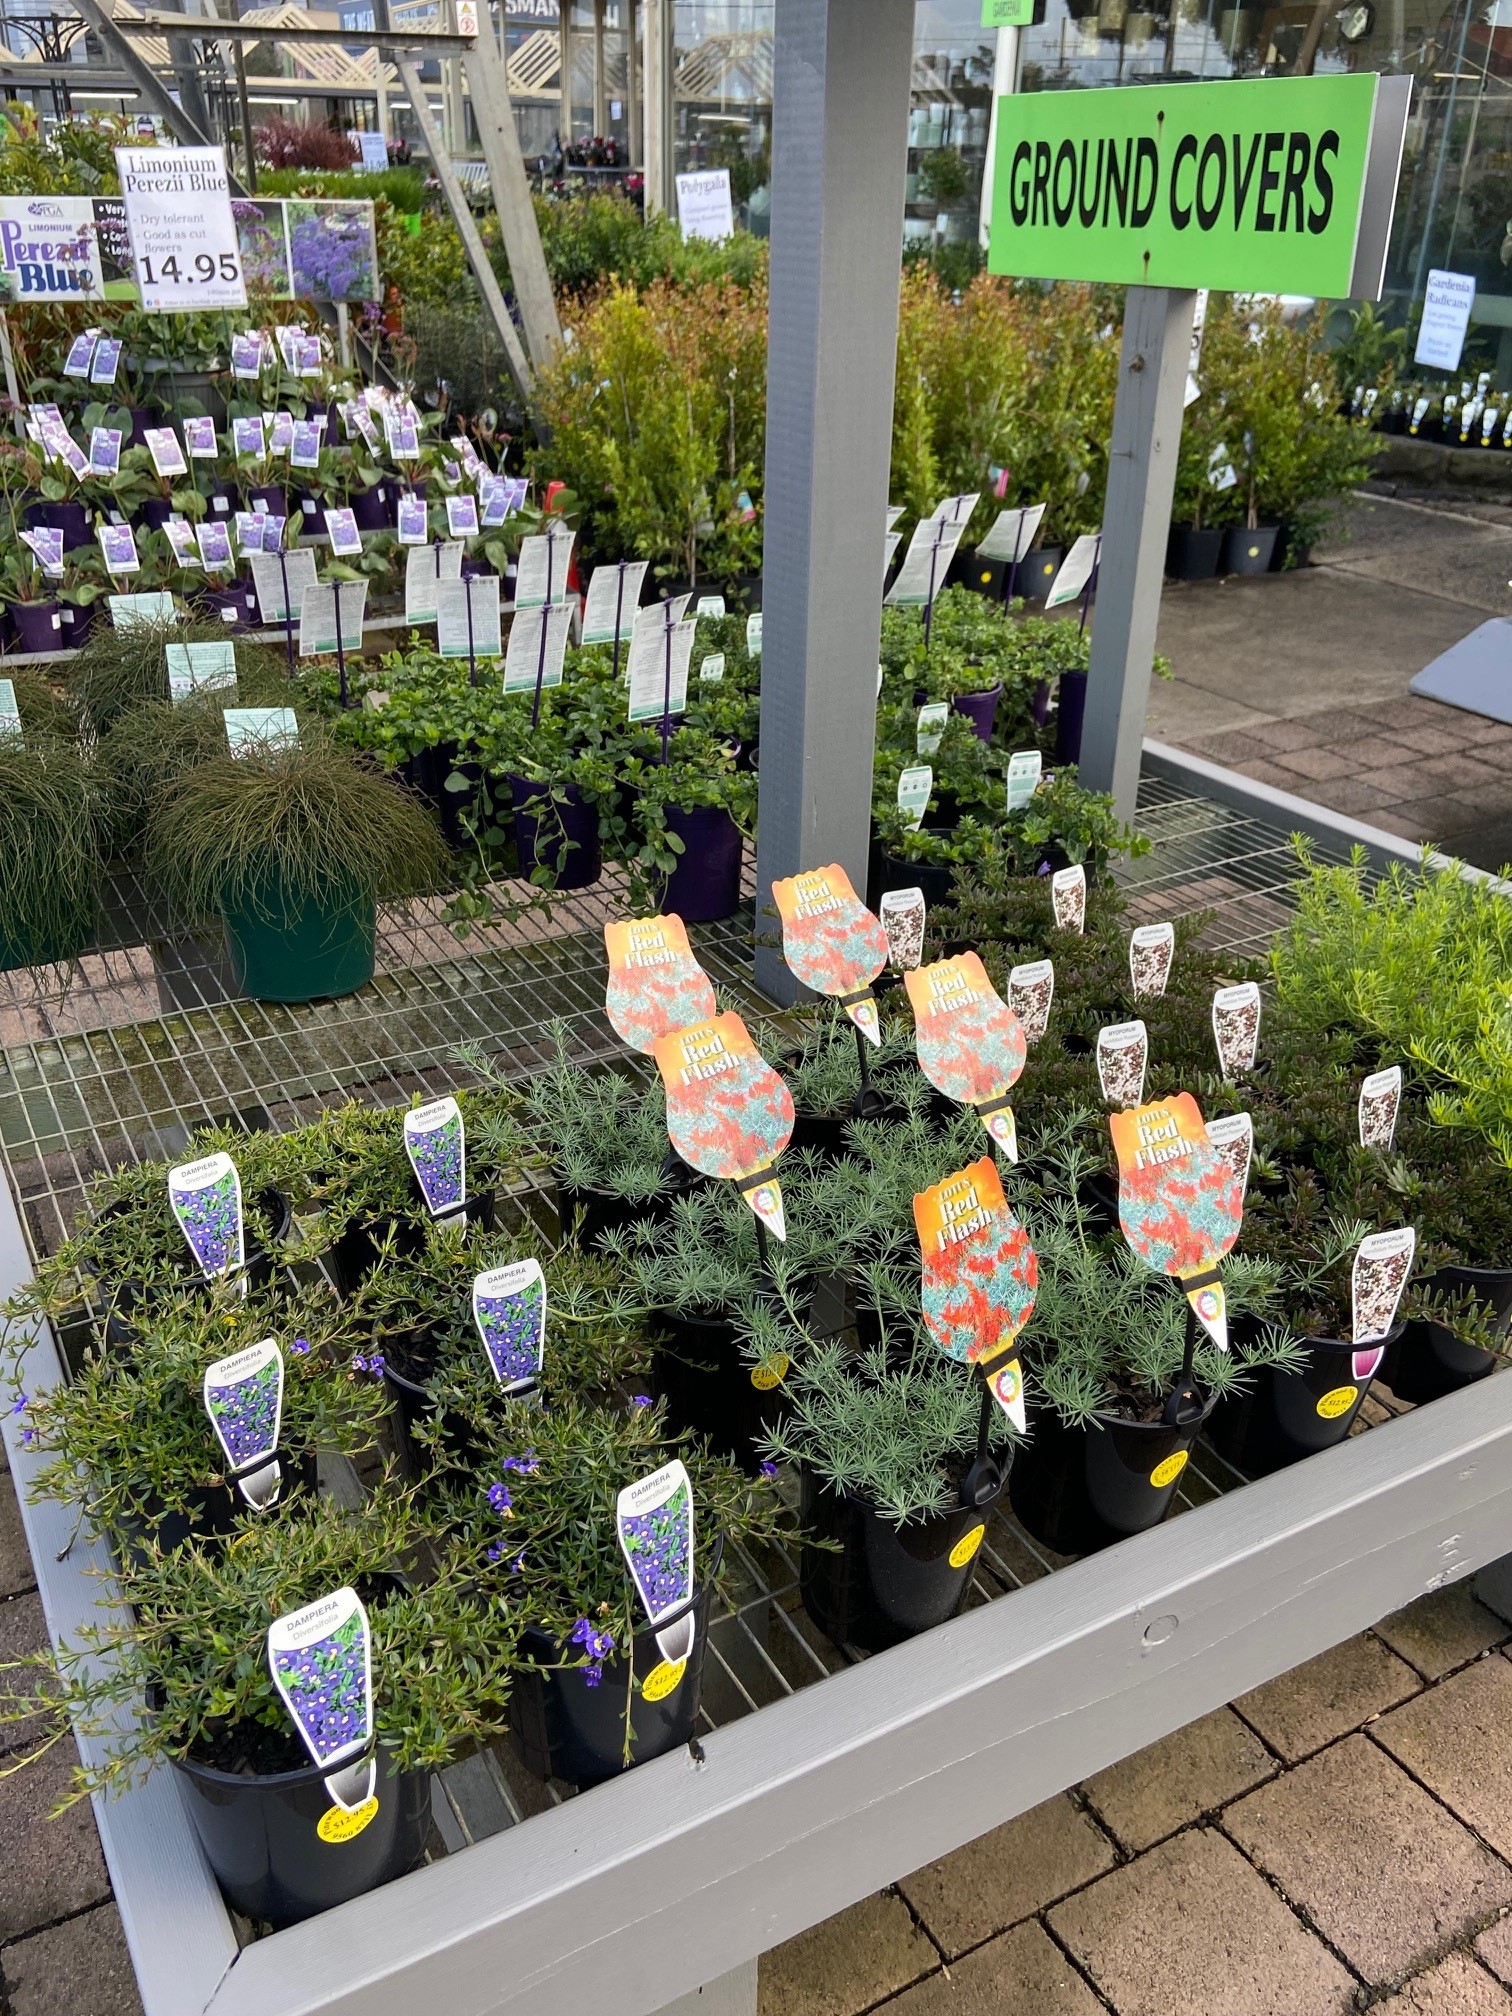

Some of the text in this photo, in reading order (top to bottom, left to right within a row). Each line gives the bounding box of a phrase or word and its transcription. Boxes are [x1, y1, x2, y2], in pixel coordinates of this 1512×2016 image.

[128, 155, 216, 174] Limonium
[126, 173, 227, 193] Perezii Blue
[1010, 129, 1340, 235] GROUND COVERS
[28, 223, 73, 232] LIMONIUM
[140, 214, 160, 225] Dry
[163, 212, 204, 223] tolerant
[143, 229, 171, 240] Good
[189, 229, 206, 239] cut
[145, 243, 182, 254] flowers
[17, 263, 96, 292] Blue
[140, 253, 239, 284] 14.95
[794, 879, 831, 905] Red
[795, 897, 845, 921] Flash
[628, 928, 665, 953] Red
[624, 949, 678, 970] Flash
[927, 972, 967, 999] Red
[1223, 988, 1250, 998] MYOPORUM
[927, 989, 982, 1018] Flash
[681, 1025, 716, 1046] LOTUS
[1108, 1026, 1136, 1037] MYOPORUM
[680, 1035, 726, 1065] Red
[678, 1050, 742, 1087] Flash
[414, 1104, 447, 1121] DAMPIERA
[418, 1112, 447, 1128] Diversifolia
[1135, 1106, 1172, 1127] LOTUS
[1136, 1114, 1180, 1147] Red
[1211, 1120, 1242, 1132] MYOPORUM
[1134, 1135, 1194, 1171] Flash
[181, 1160, 218, 1178] DAMPIERA
[185, 1169, 219, 1185] Diversifolia
[937, 1175, 973, 1201] LOTUS
[938, 1185, 980, 1226] Red
[935, 1207, 993, 1252] Flash
[1370, 1234, 1404, 1247] MYOPORUM
[487, 1267, 527, 1284] DAMPIERA
[491, 1276, 526, 1292] Diversifolia
[220, 1349, 263, 1373] DAMPIERA
[223, 1358, 262, 1380] Diversifolia
[631, 1472, 671, 1500] DAMPIERA
[635, 1484, 671, 1509] Diversifolia
[286, 1600, 339, 1632] DAMPIERA
[292, 1613, 339, 1641] Diversifolia
[323, 1806, 342, 1836] Pinewoo
[333, 1807, 366, 1829] $12.95
[332, 1830, 354, 1839] 9560
